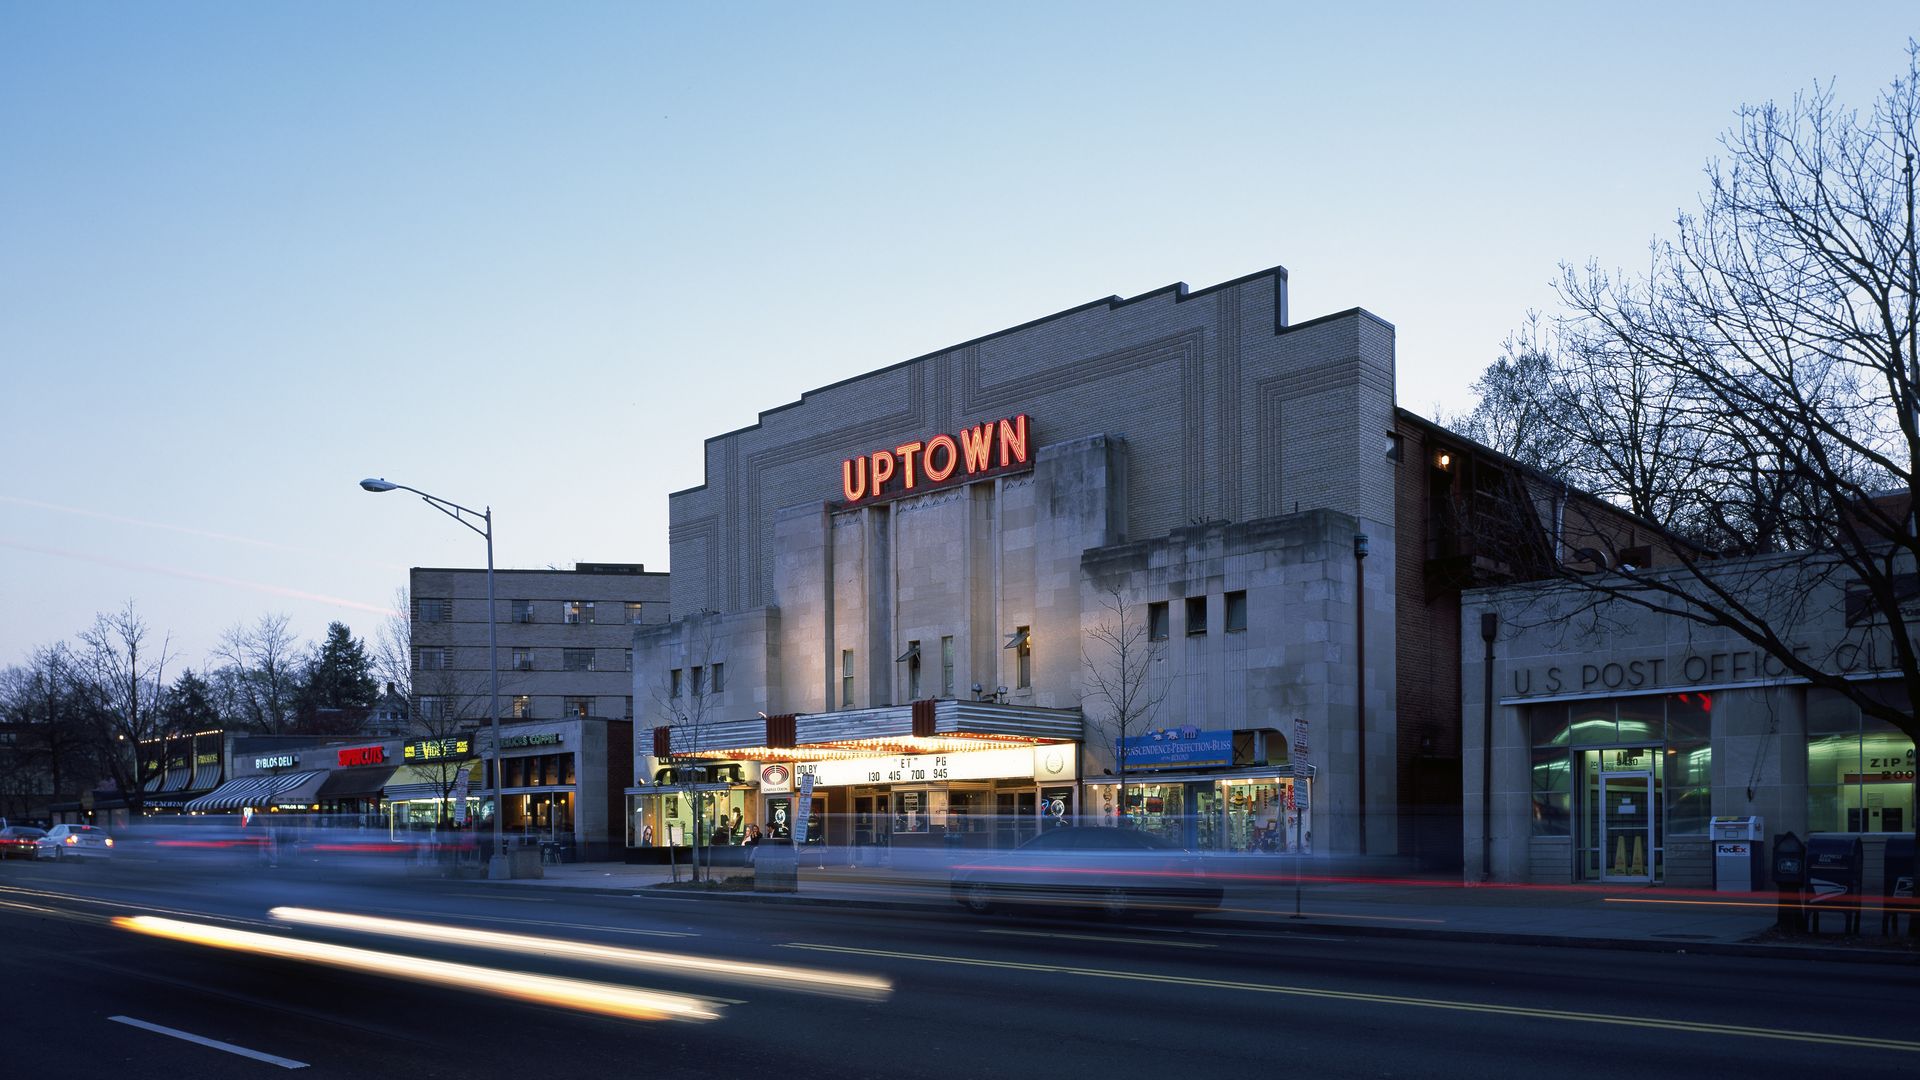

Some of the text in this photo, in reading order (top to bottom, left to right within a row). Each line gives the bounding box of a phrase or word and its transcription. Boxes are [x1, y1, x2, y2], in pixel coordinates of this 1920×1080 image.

[842, 413, 1030, 503] UPTOWN
[1583, 659, 1664, 689] POST
[255, 756, 293, 769] BYBLOS DELI
[338, 746, 384, 767] SUPERCUTS
[935, 756, 947, 766] PG
[1870, 758, 1901, 768] ZIP
[797, 764, 817, 775] DOLBY
[868, 768, 948, 782] 130 415 700 945
[1718, 845, 1747, 854] FedEx
